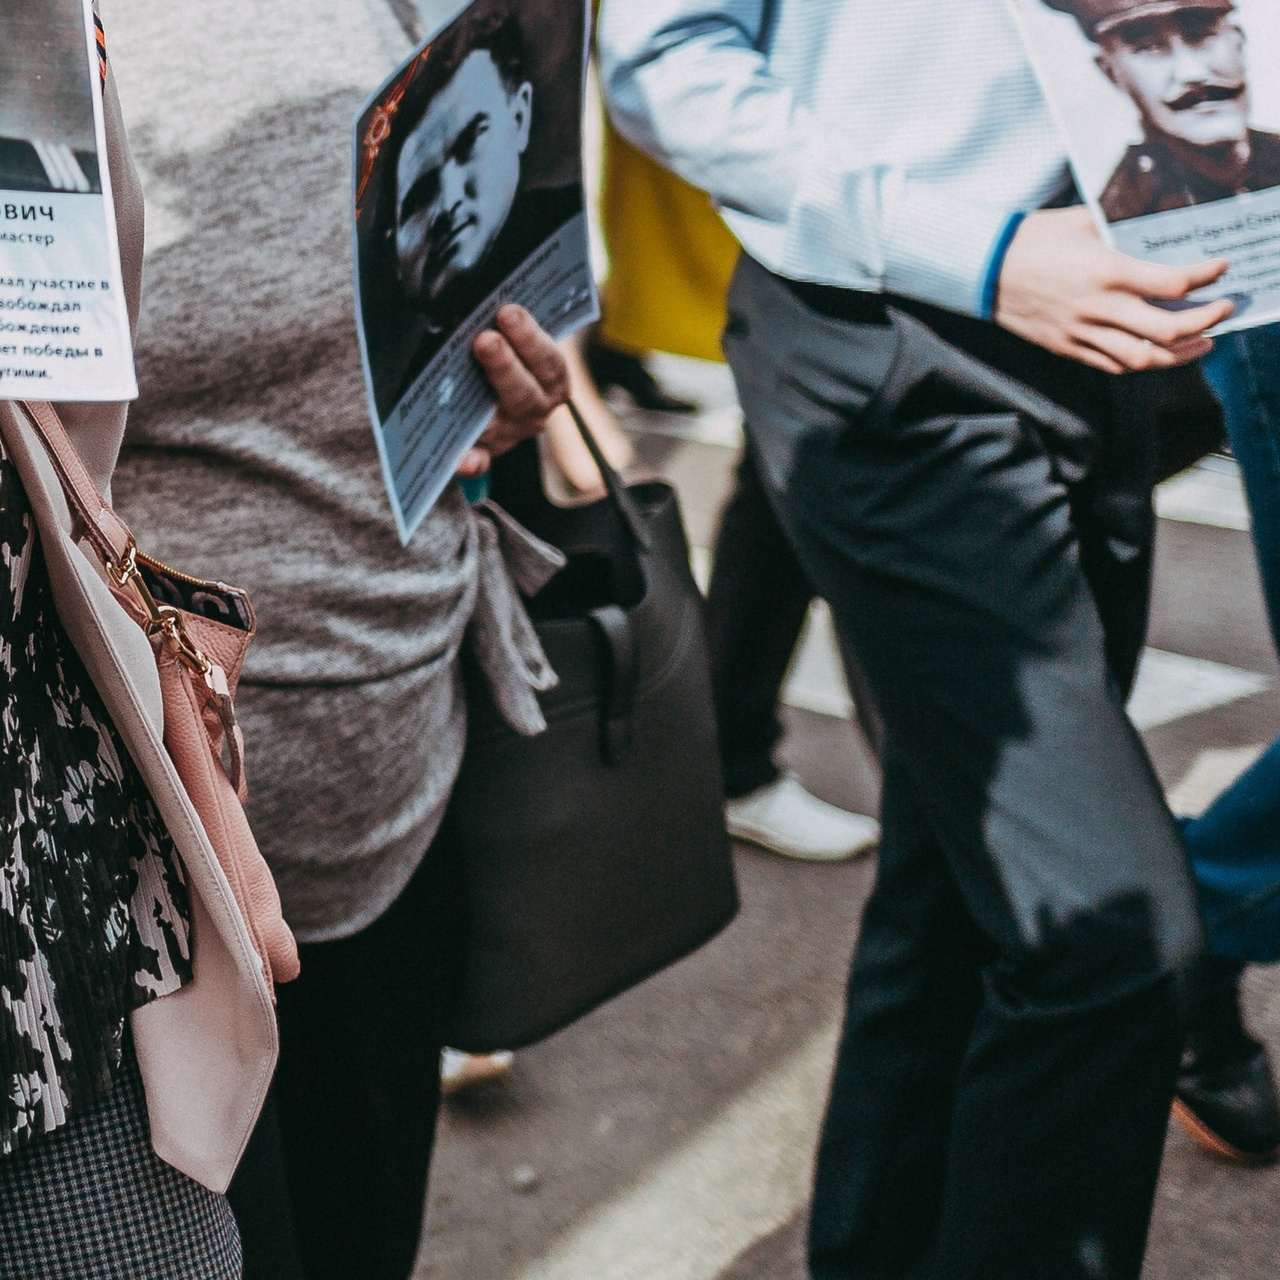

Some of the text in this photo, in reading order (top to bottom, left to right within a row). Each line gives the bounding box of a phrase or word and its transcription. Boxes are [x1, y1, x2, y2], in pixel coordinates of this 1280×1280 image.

[31, 278, 95, 292] участие
[101, 280, 110, 290] в
[23, 343, 89, 359] победы
[95, 348, 103, 357] в
